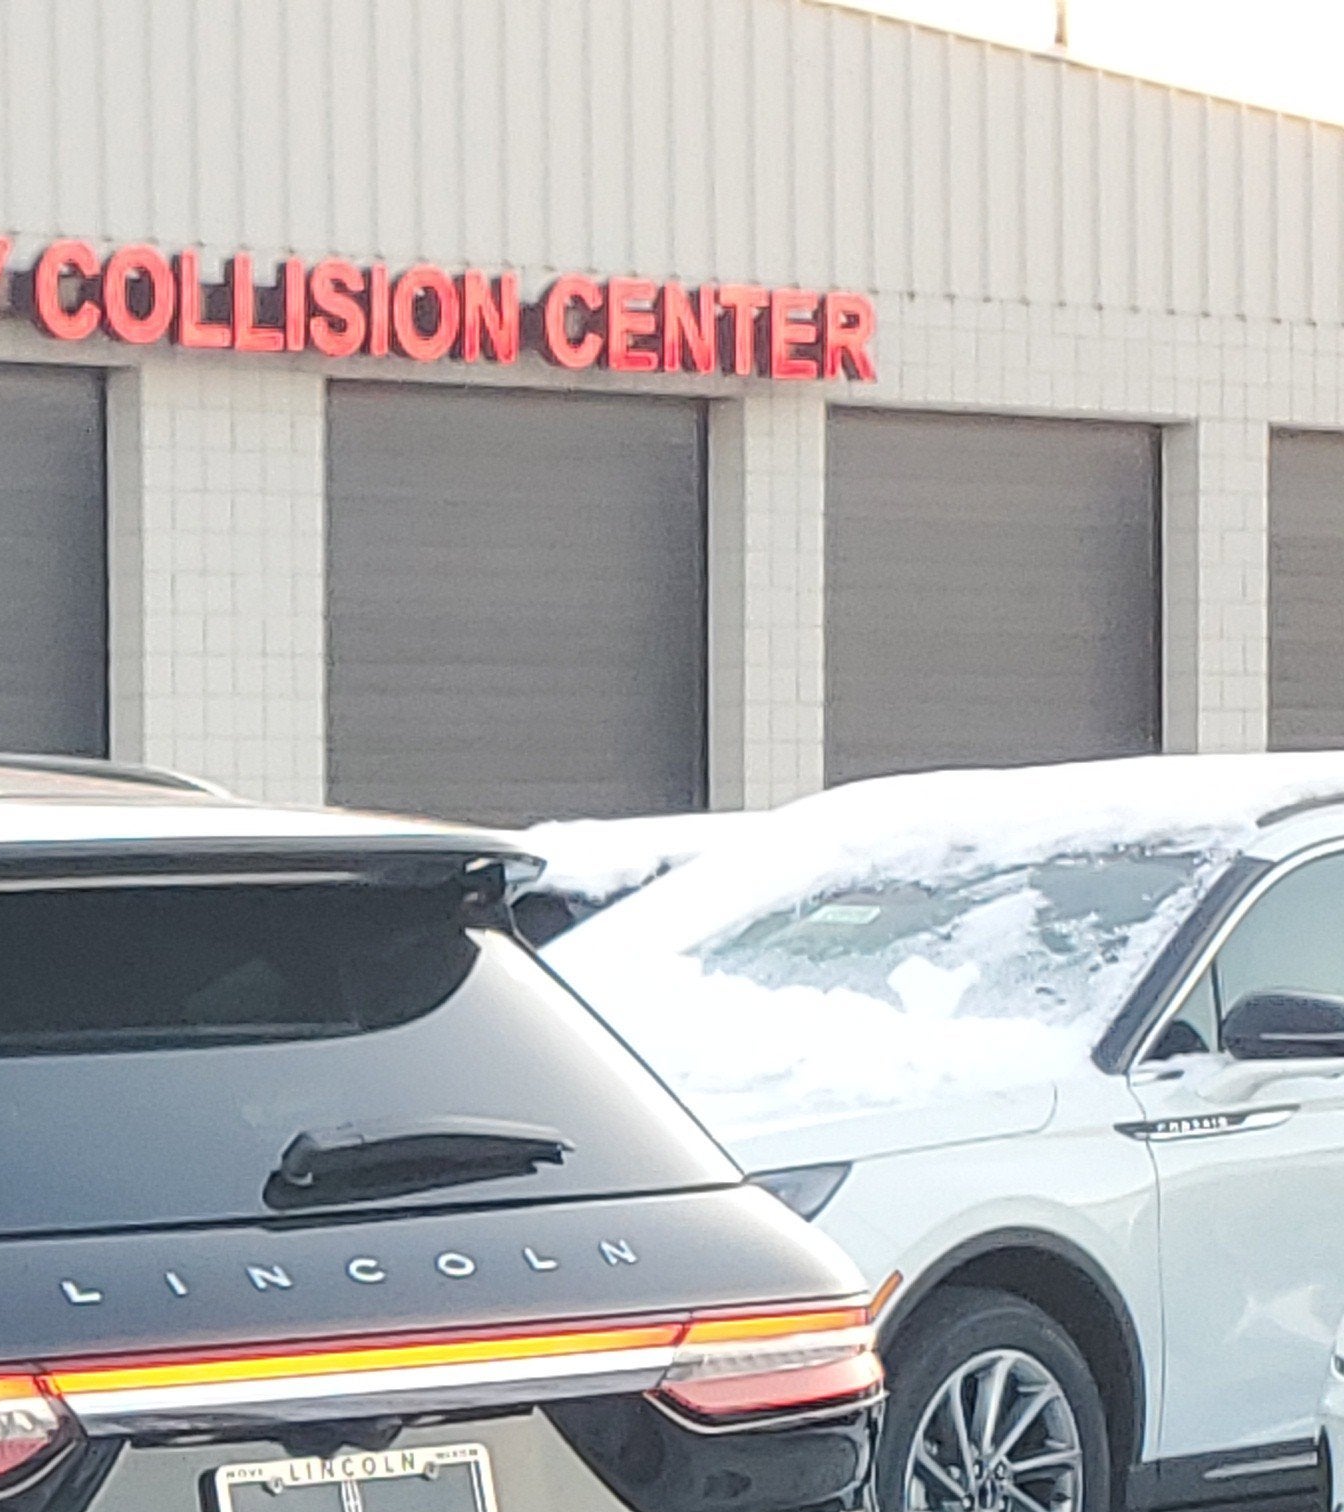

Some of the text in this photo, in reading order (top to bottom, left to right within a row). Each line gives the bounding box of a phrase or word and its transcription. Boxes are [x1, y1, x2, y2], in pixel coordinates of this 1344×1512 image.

[34, 238, 518, 364] COLLISION
[544, 272, 877, 381] CENTER
[61, 1239, 638, 1303] LINCOLN
[289, 1451, 416, 1482] LINCOLN
